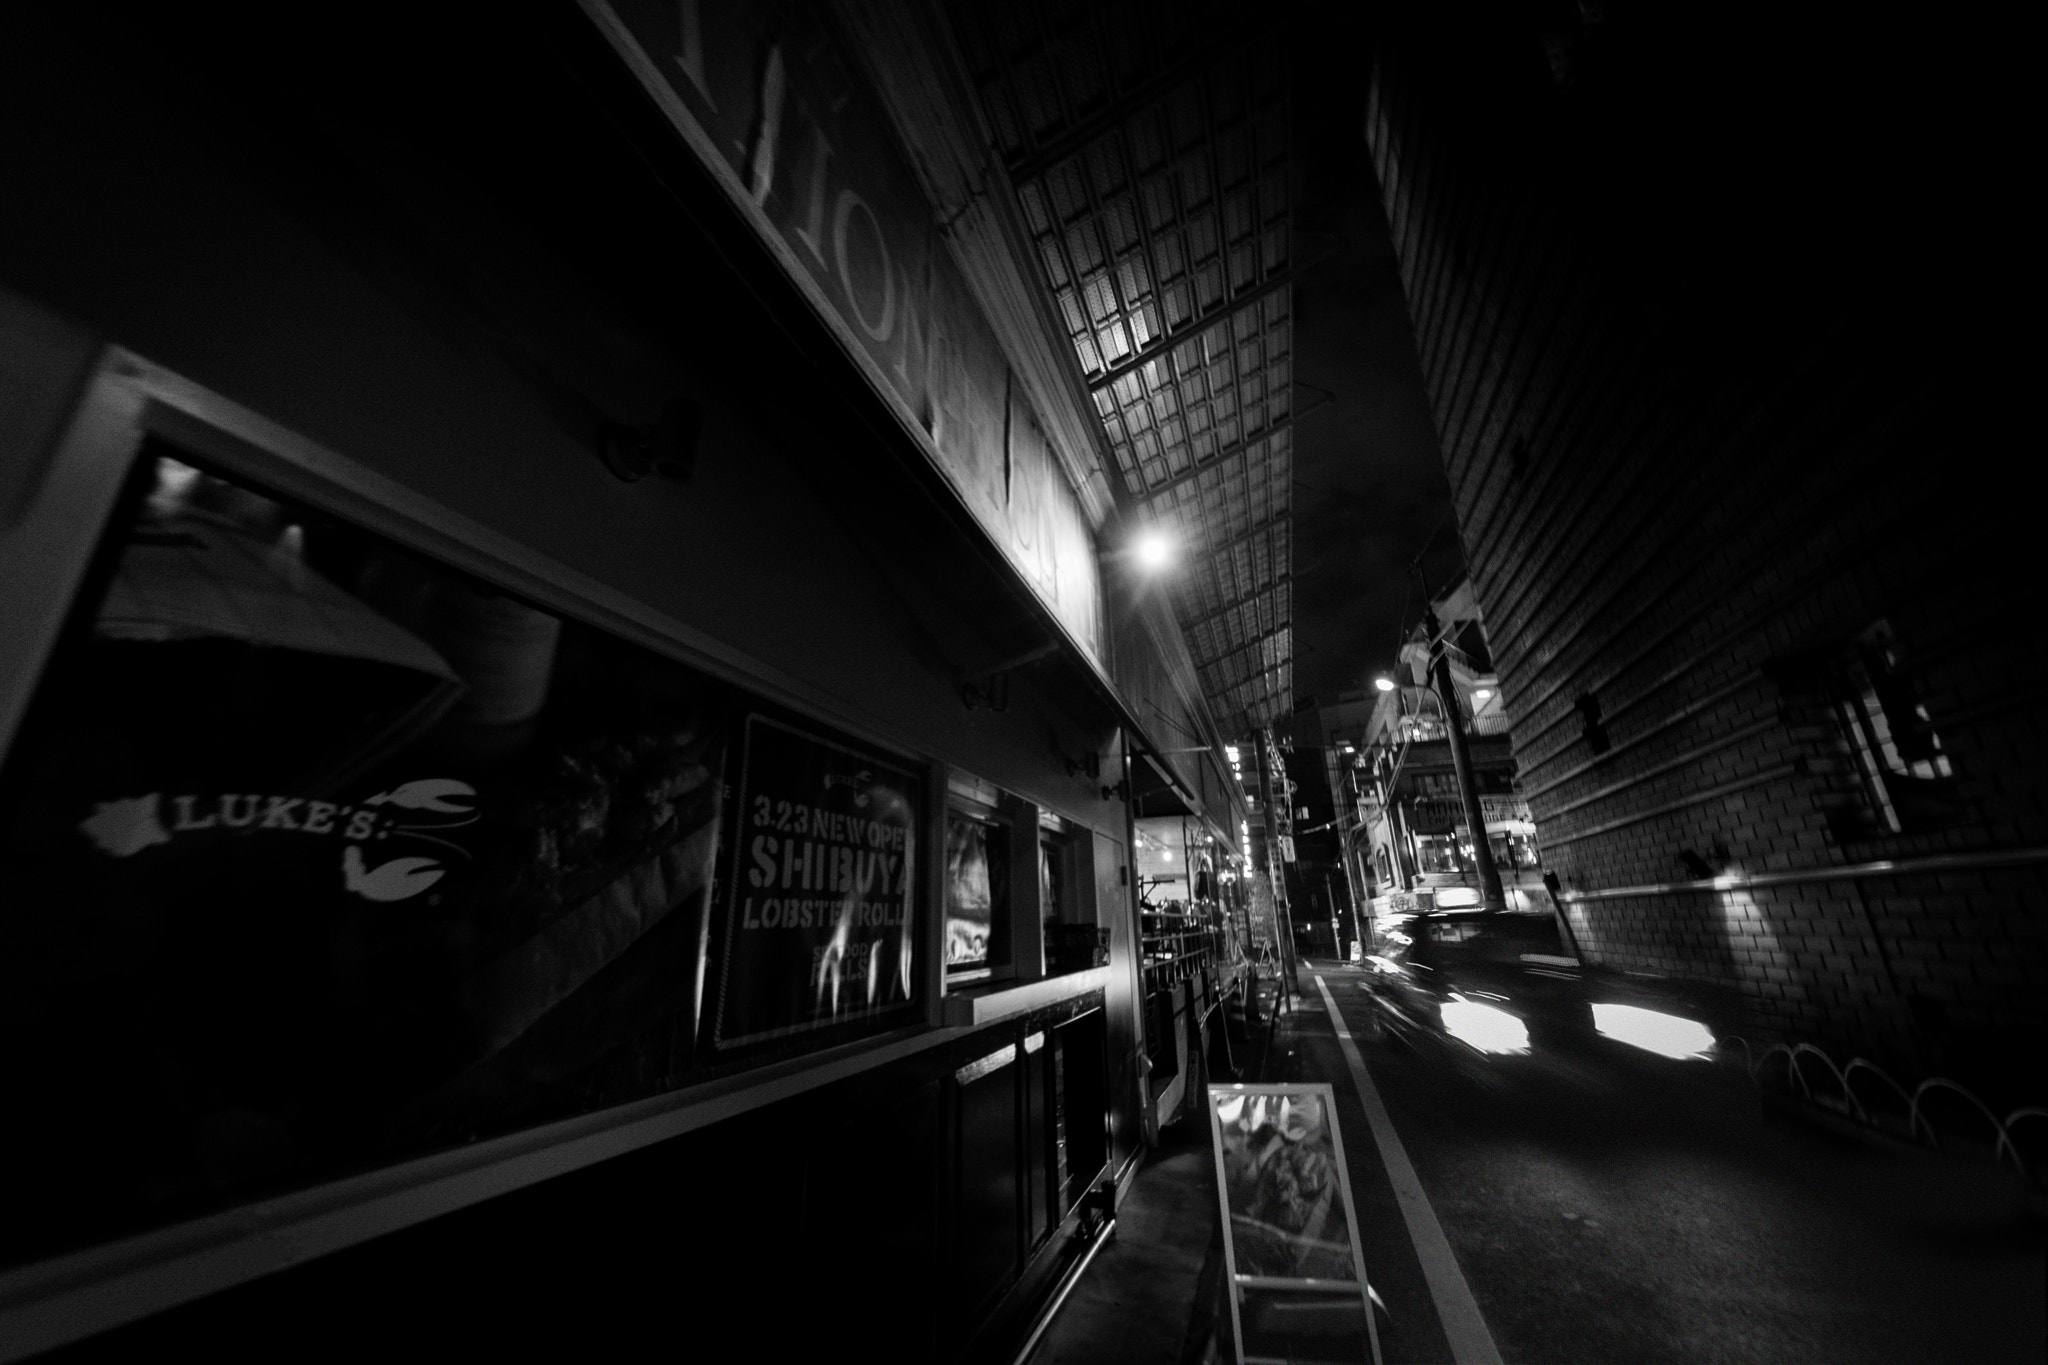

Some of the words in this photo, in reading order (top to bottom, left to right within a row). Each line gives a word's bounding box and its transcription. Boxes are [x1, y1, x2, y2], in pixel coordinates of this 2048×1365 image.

[752, 794, 809, 834] 3.23
[812, 808, 866, 845] NEW
[867, 821, 914, 852] OPE
[743, 896, 853, 930] LOBSTE
